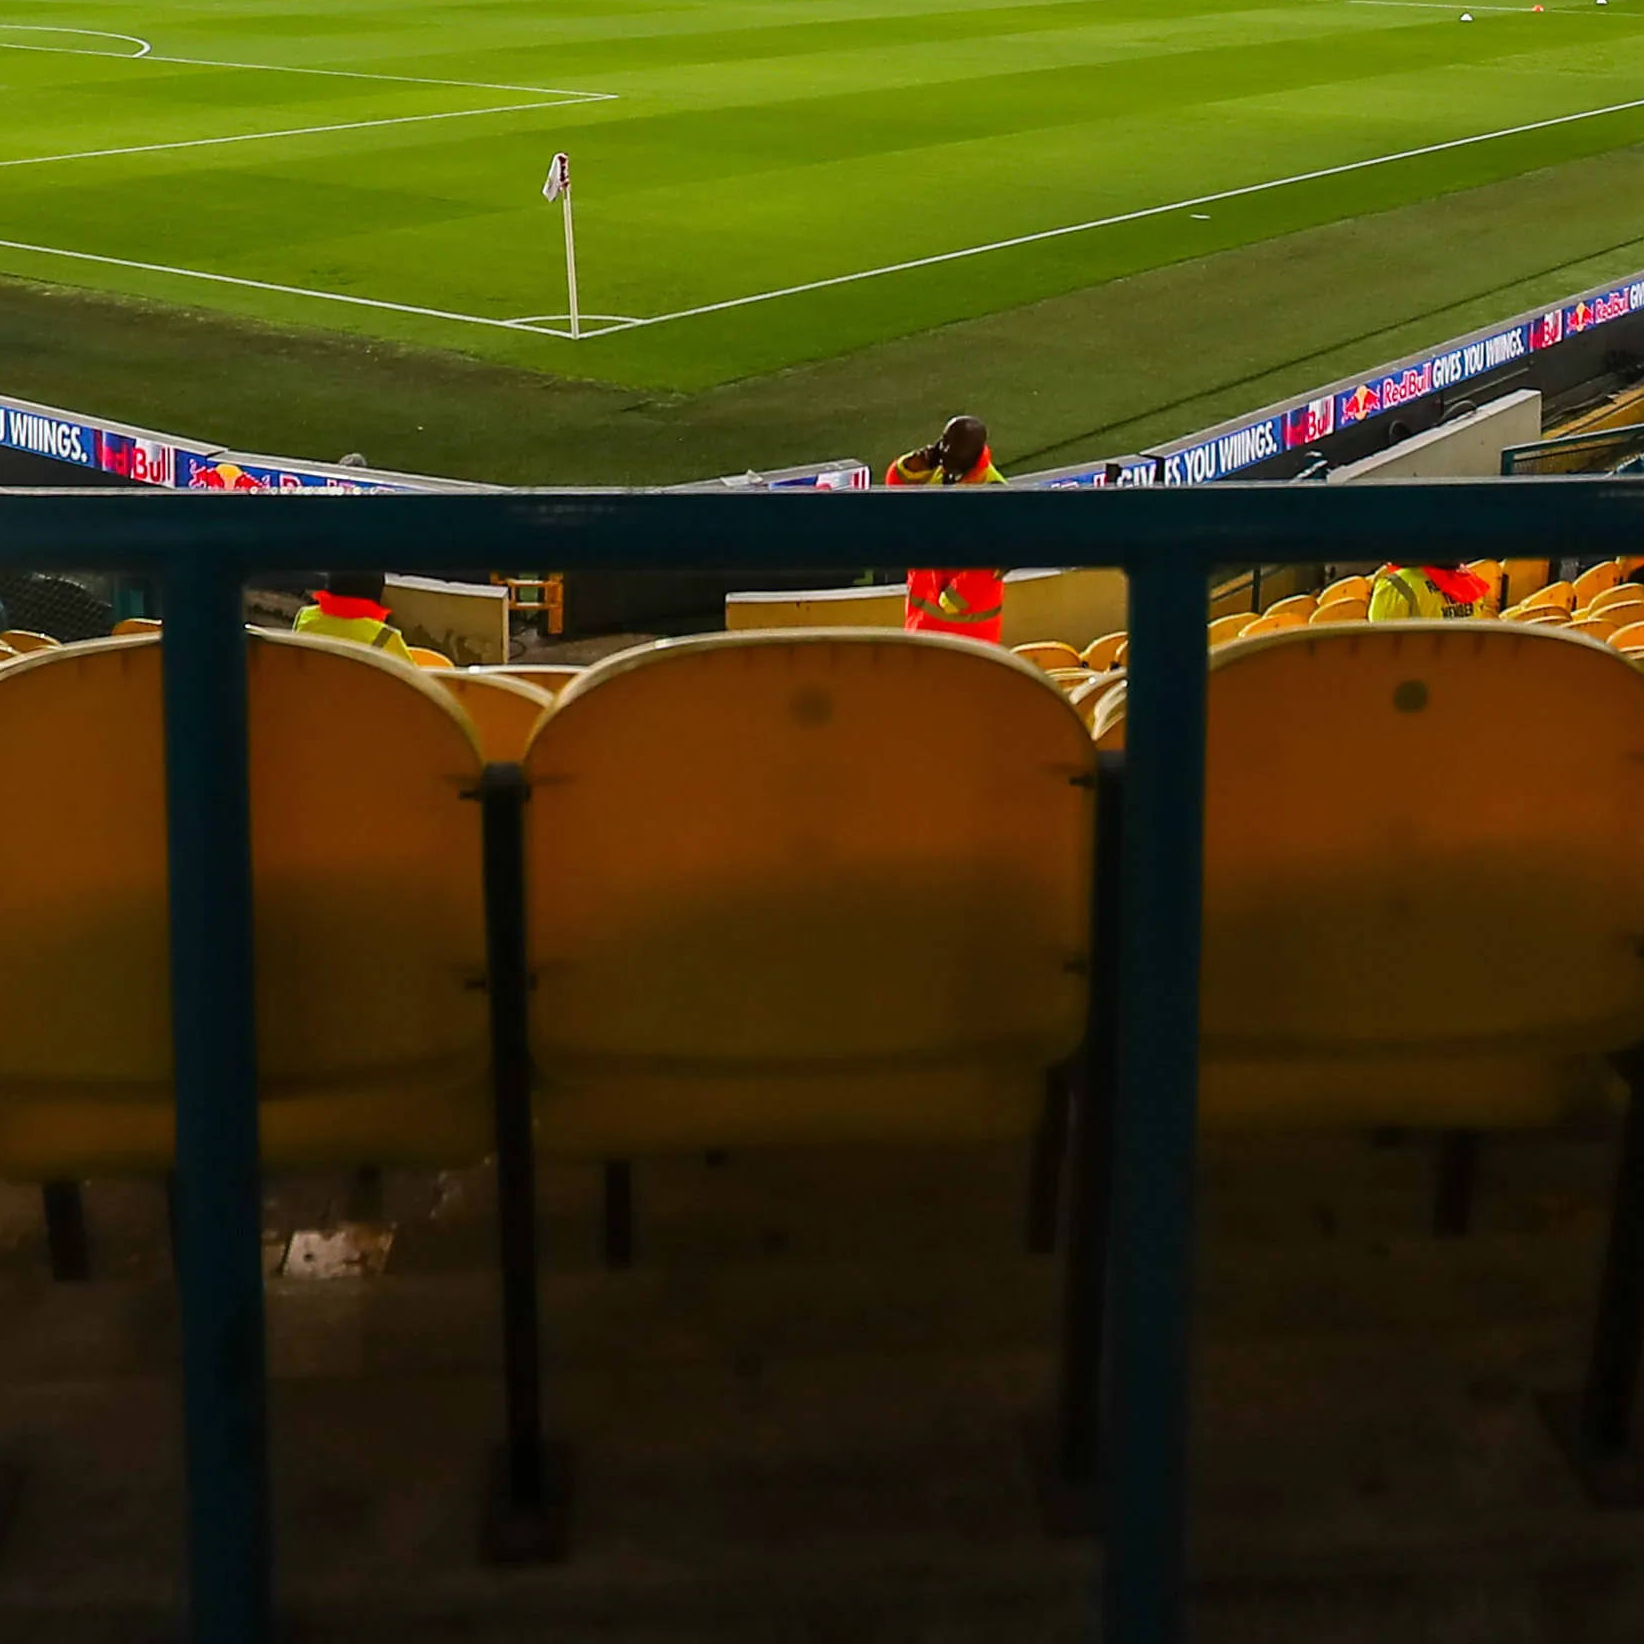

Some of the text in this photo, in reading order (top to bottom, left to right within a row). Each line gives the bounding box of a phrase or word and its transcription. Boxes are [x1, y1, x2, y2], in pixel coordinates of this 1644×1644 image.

[1432, 354, 1462, 388] GIVES
[1463, 344, 1484, 377] YOU
[8, 409, 88, 463] WIIINGS.
[1184, 443, 1216, 486] YOU
